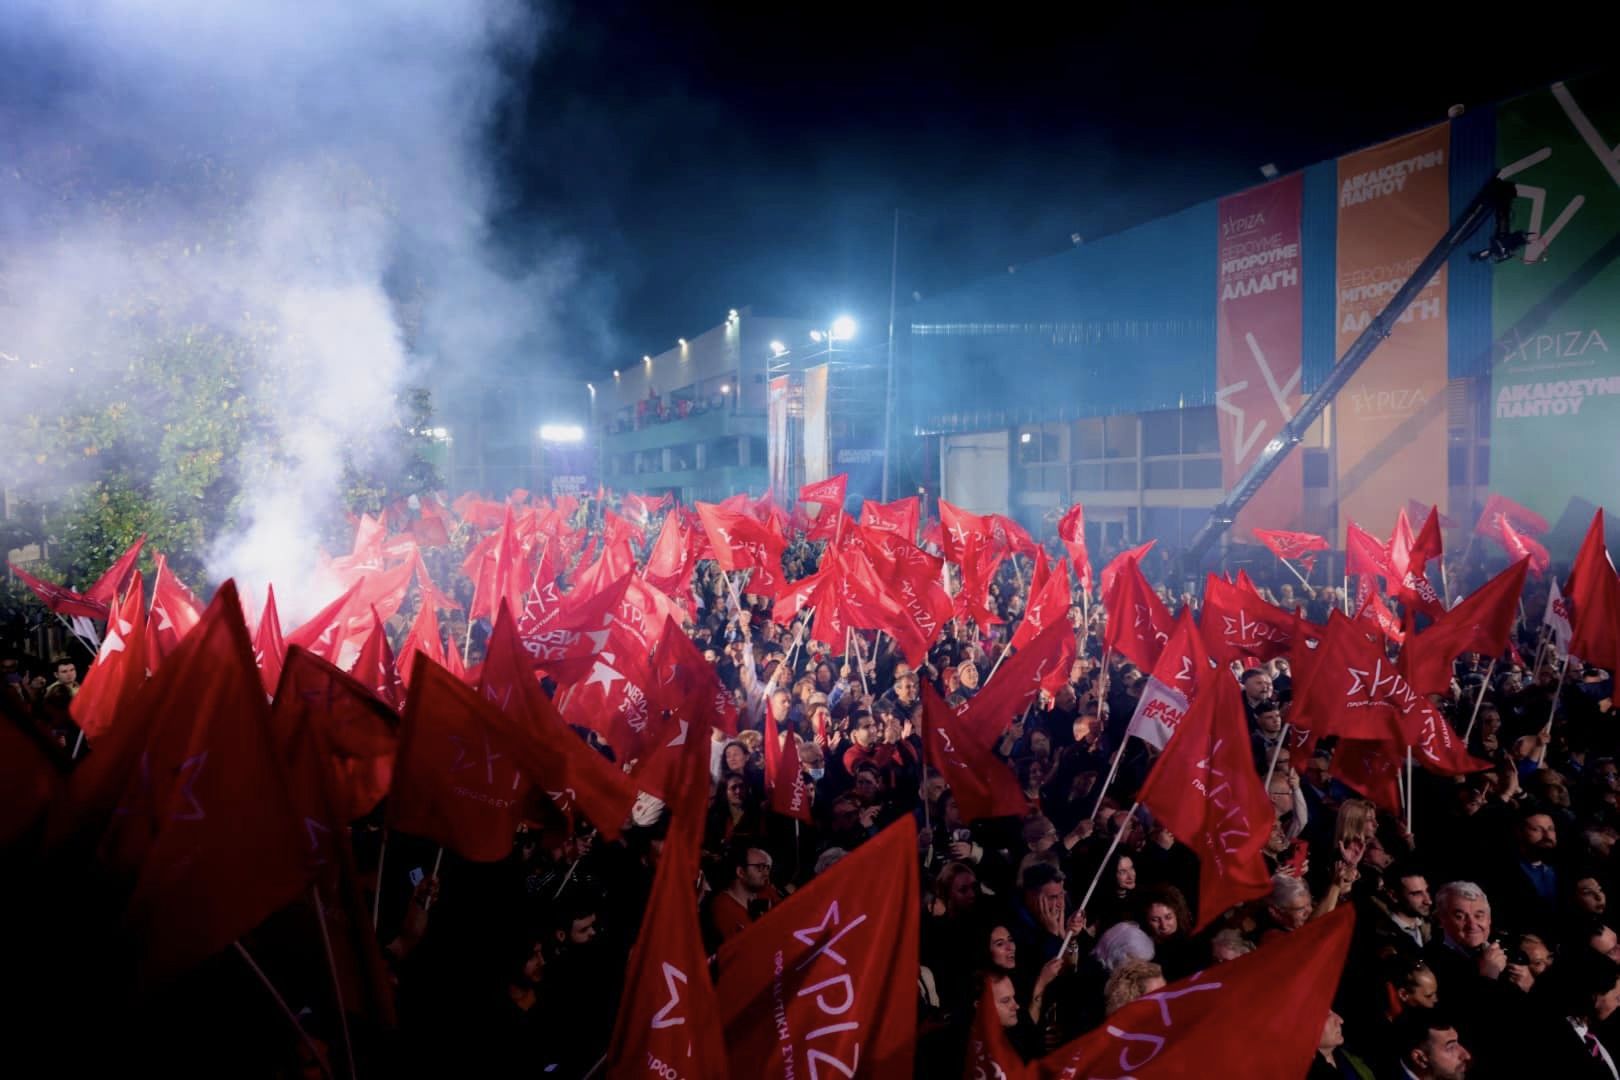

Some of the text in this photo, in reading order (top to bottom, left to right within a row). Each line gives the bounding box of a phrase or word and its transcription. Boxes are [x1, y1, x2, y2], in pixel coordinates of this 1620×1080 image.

[1340, 175, 1406, 208] ΠΑΝΤΟΥ
[1222, 243, 1298, 274] ΜΠΟΡΟΥΜΕ
[1222, 267, 1297, 302] ΑΛΛΑΓΗ
[1496, 396, 1584, 418] ΠΑΝΤΟΥ
